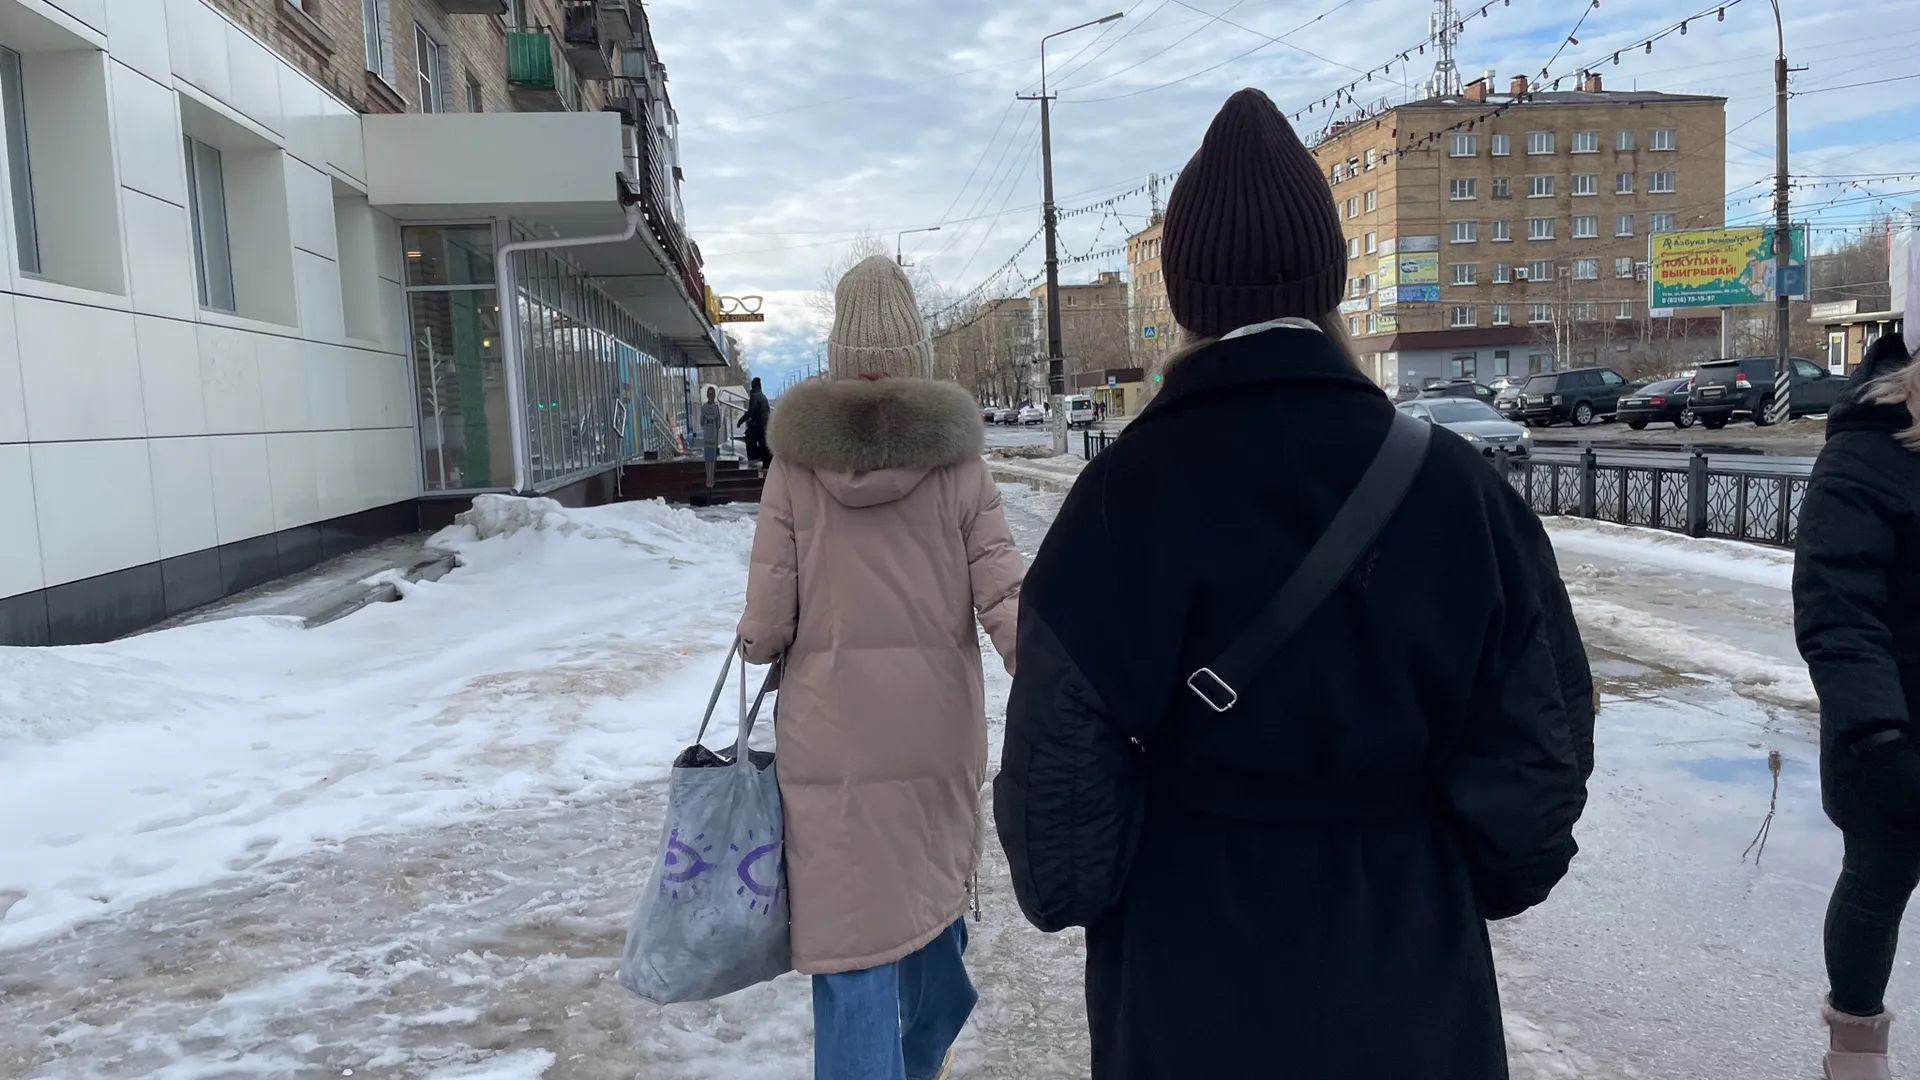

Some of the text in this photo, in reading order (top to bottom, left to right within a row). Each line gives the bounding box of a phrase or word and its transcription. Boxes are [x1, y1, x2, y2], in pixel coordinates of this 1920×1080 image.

[1673, 239, 1706, 247] Азбука
[1662, 254, 1719, 268] ПОКУПАЙ
[1661, 266, 1737, 278] ВЫИГРЫВАЙ!
[1783, 269, 1799, 295] P
